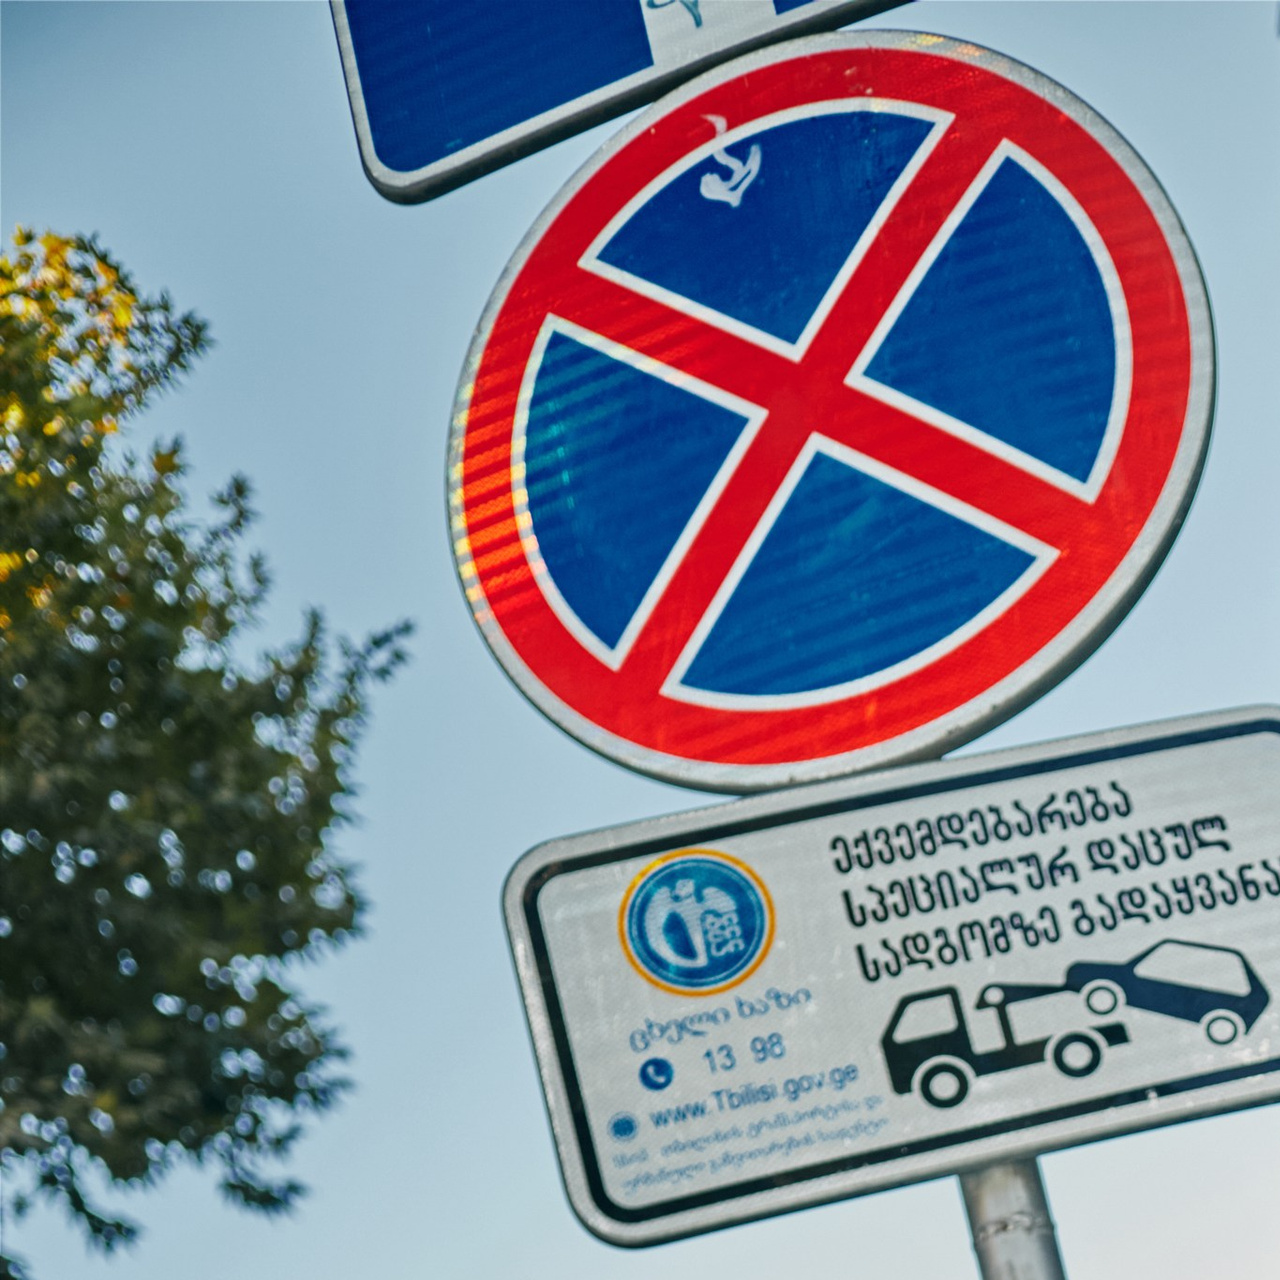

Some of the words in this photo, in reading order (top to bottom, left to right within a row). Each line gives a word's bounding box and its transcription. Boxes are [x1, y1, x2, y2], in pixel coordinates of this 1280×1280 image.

[830, 780, 1132, 874] ექვემდებარება
[841, 846, 1079, 928] სპეციალურ
[1086, 815, 1231, 875] დაცულ
[856, 905, 1061, 983] სადგომზე
[703, 1044, 736, 1073] 13
[750, 1032, 786, 1063] 98
